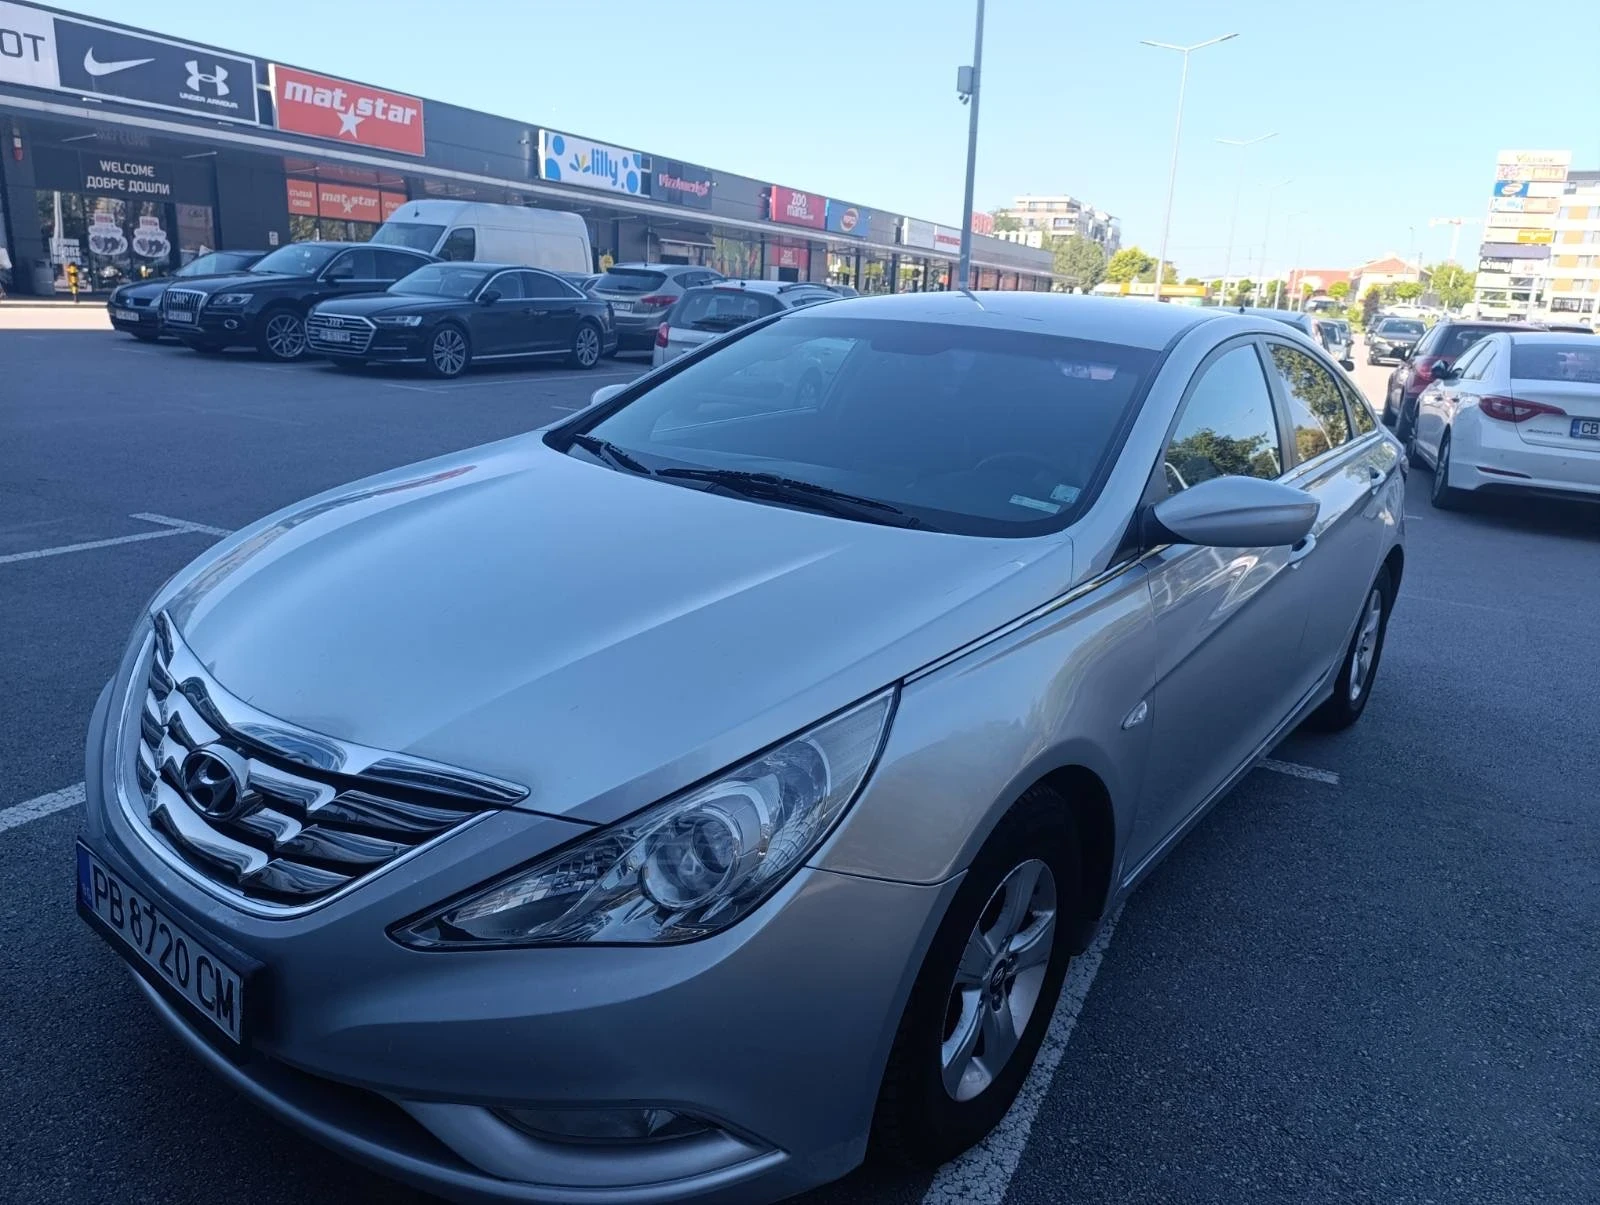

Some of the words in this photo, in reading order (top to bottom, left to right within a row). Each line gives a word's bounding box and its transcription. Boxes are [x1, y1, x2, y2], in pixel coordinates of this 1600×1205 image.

[179, 92, 206, 103] UNDER
[206, 97, 239, 109] ARMOUR
[284, 80, 347, 112] mat
[356, 97, 417, 125] star
[99, 160, 156, 177] WELCOME
[591, 148, 618, 186] lilly
[86, 175, 126, 191] ДОБРЕ
[128, 179, 171, 196] ДОШЛИ
[321, 191, 347, 204] mat
[351, 195, 378, 207] star
[1581, 422, 1599, 435] CB
[92, 864, 125, 930] PB
[129, 897, 190, 989] 8720
[196, 955, 235, 1032] CM
